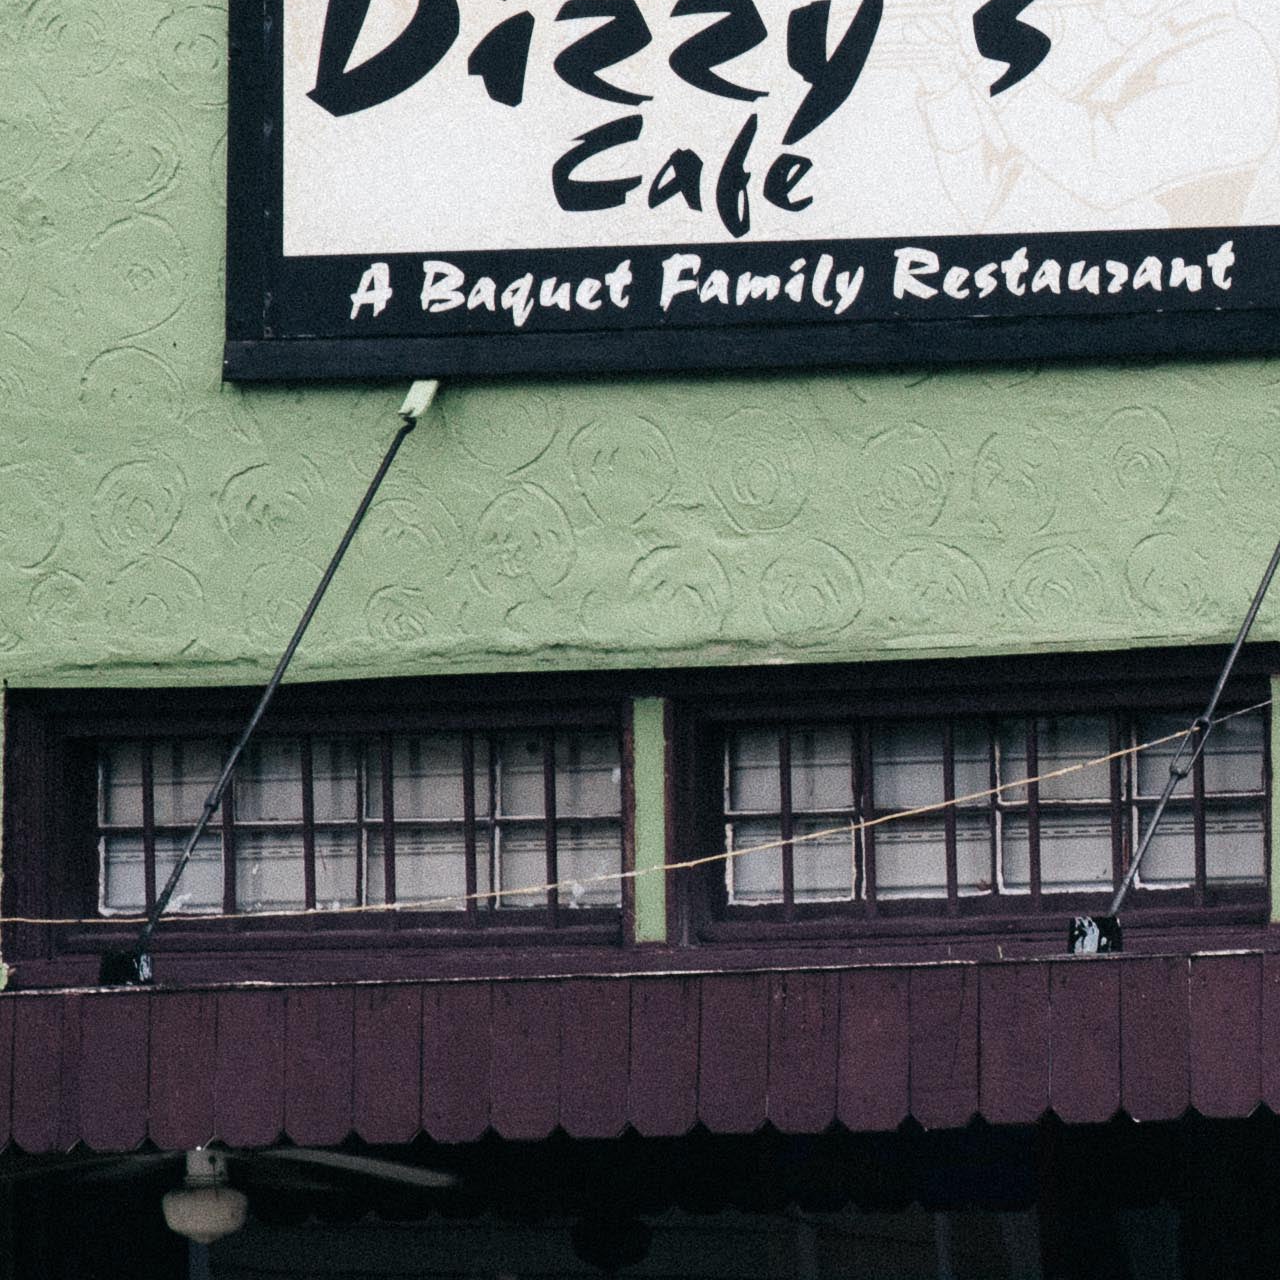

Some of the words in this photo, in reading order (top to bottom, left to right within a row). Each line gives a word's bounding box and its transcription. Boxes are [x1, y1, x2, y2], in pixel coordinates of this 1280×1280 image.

[350, 262, 393, 320] A
[420, 260, 633, 327] Baquet
[659, 252, 865, 315] Family
[893, 240, 1236, 300] Restaurant
